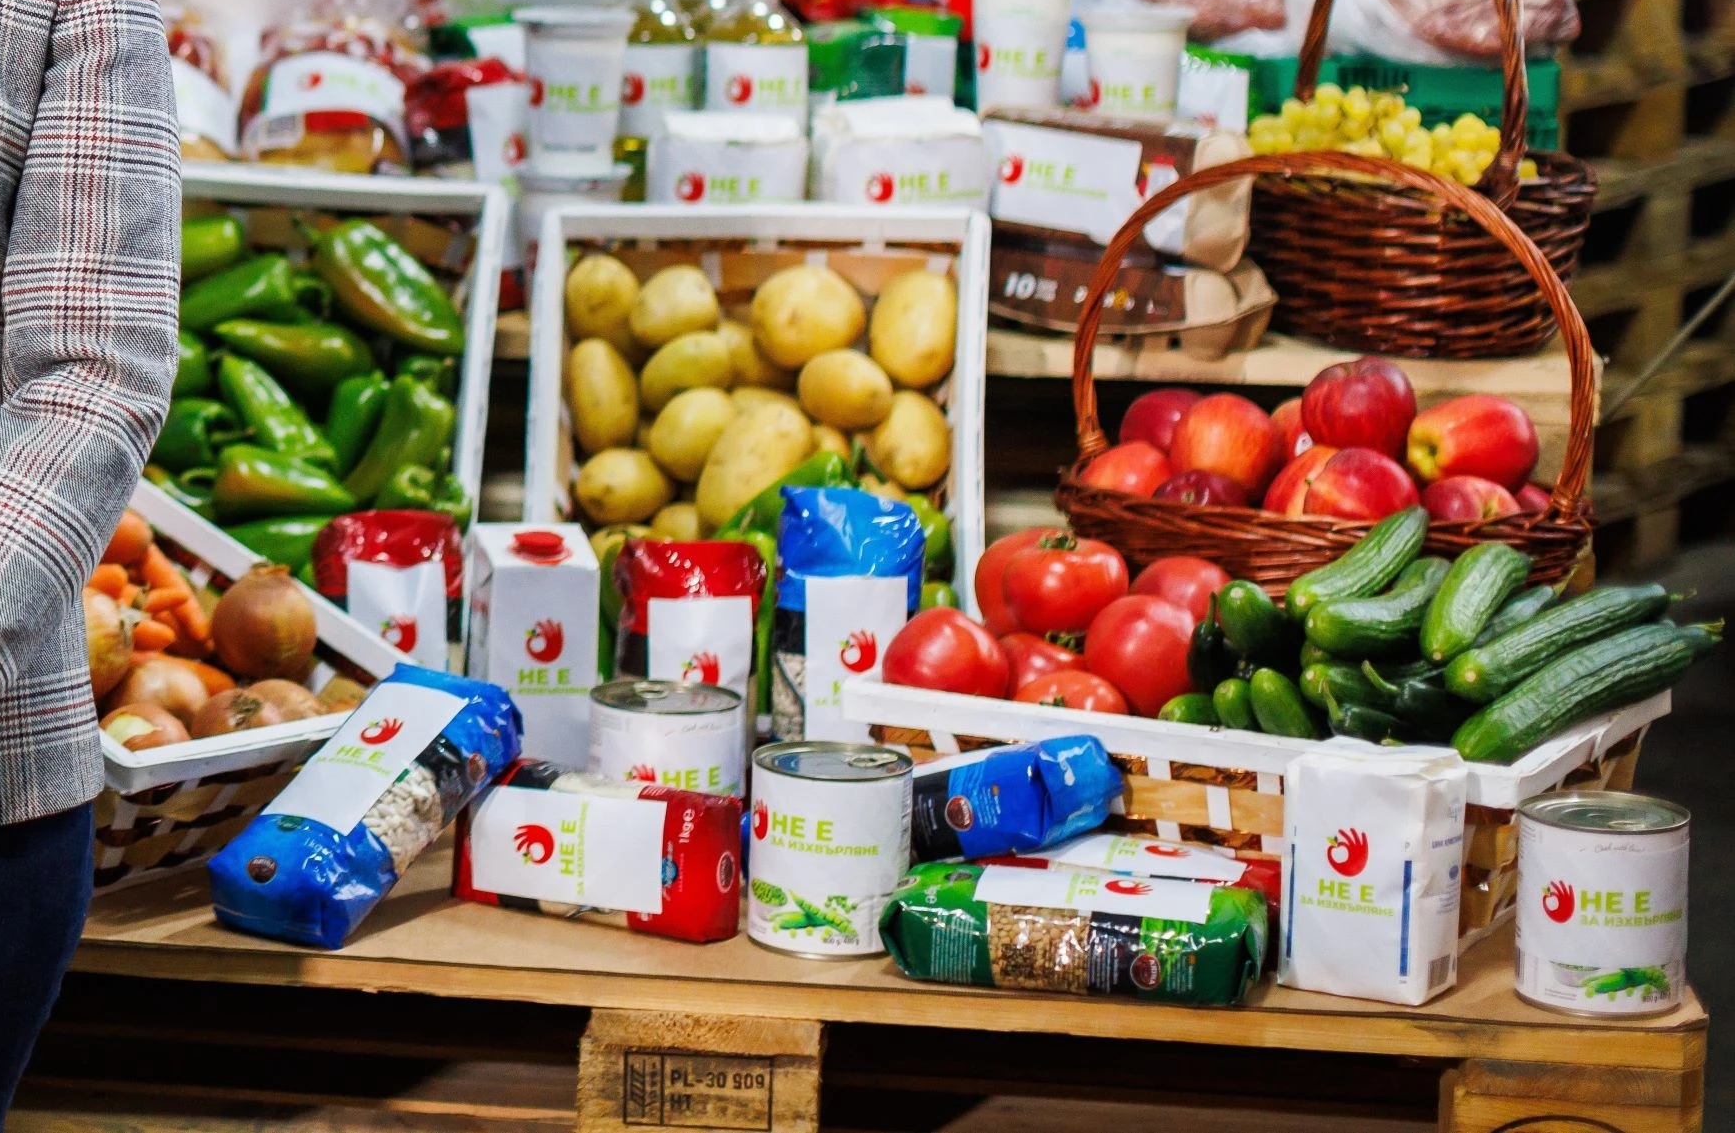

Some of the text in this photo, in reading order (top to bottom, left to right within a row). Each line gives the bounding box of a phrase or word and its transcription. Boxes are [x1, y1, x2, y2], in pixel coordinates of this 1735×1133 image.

[517, 667, 570, 685] НЕ Е
[337, 744, 387, 763] НЕ Е
[661, 765, 722, 790] НЕ Е
[771, 810, 834, 842] НЕ Е
[559, 819, 577, 876] НЕ Е
[770, 835, 880, 857] ЗА ИЗХВЪРЛЯНЕ
[1299, 894, 1315, 906] ЗА
[1318, 877, 1375, 904] НЕ Е
[1579, 889, 1652, 915] НЕ Е
[1579, 914, 1599, 926] ЗА
[670, 1068, 727, 1089] PL-30
